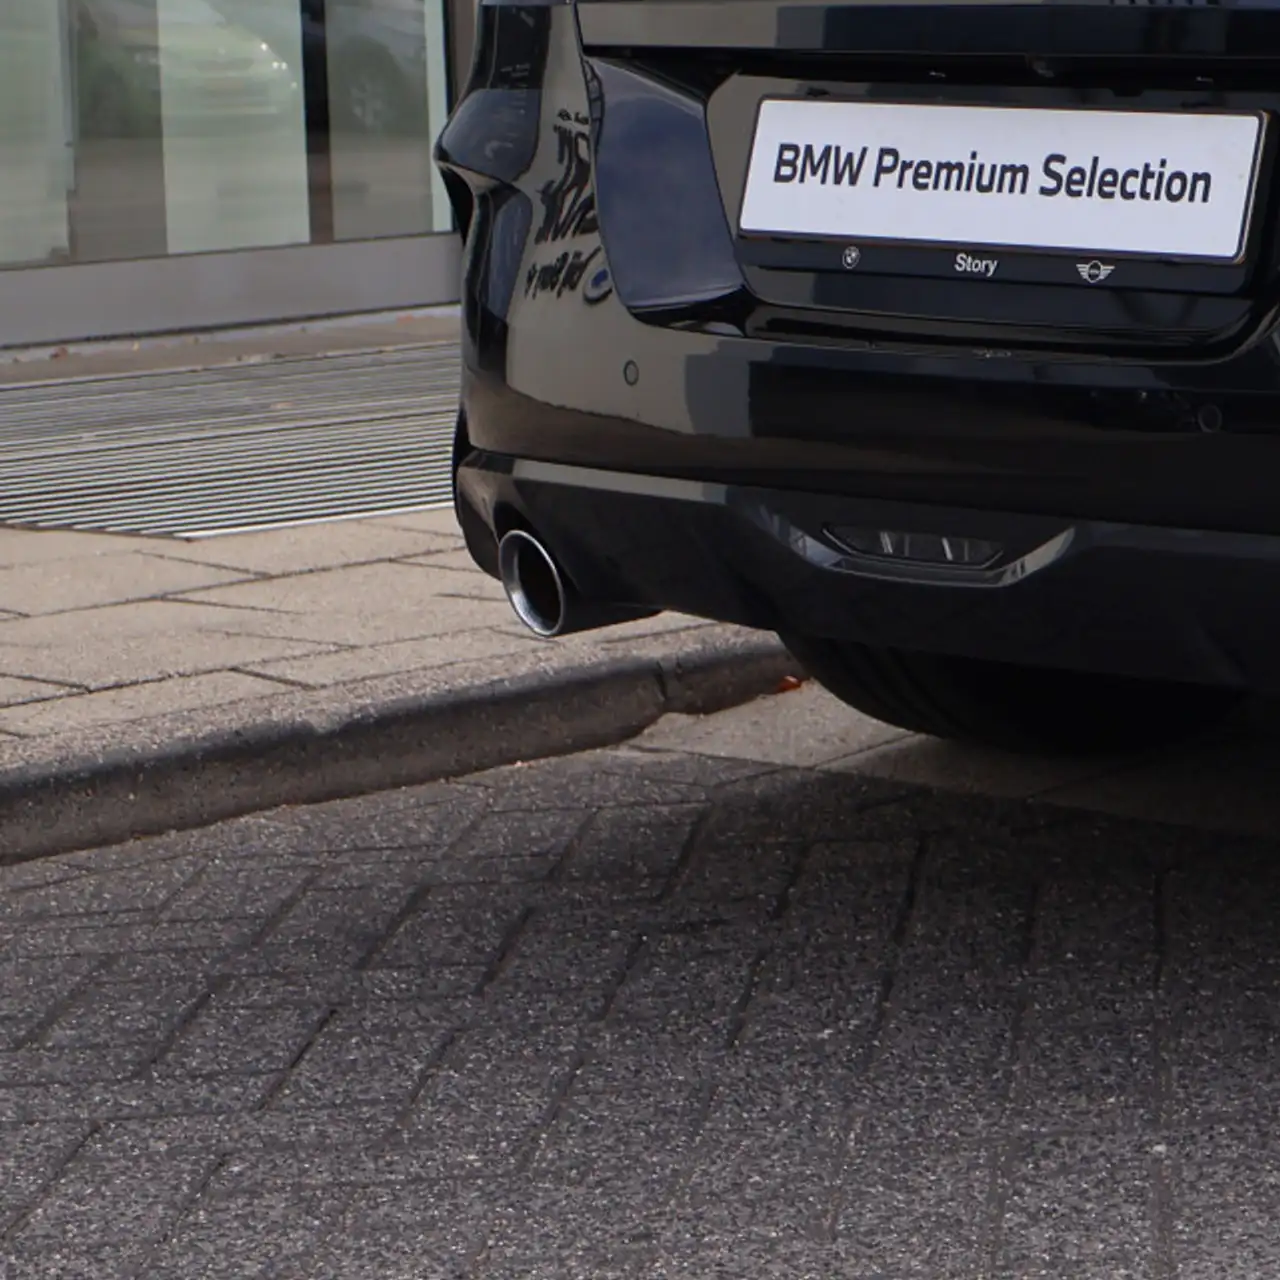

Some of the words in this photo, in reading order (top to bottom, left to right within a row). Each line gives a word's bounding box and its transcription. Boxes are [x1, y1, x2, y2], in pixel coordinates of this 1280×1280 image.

[773, 143, 868, 187] BMW
[873, 147, 1029, 194] Premium
[1038, 153, 1212, 203] Selection
[954, 252, 998, 277] Story
